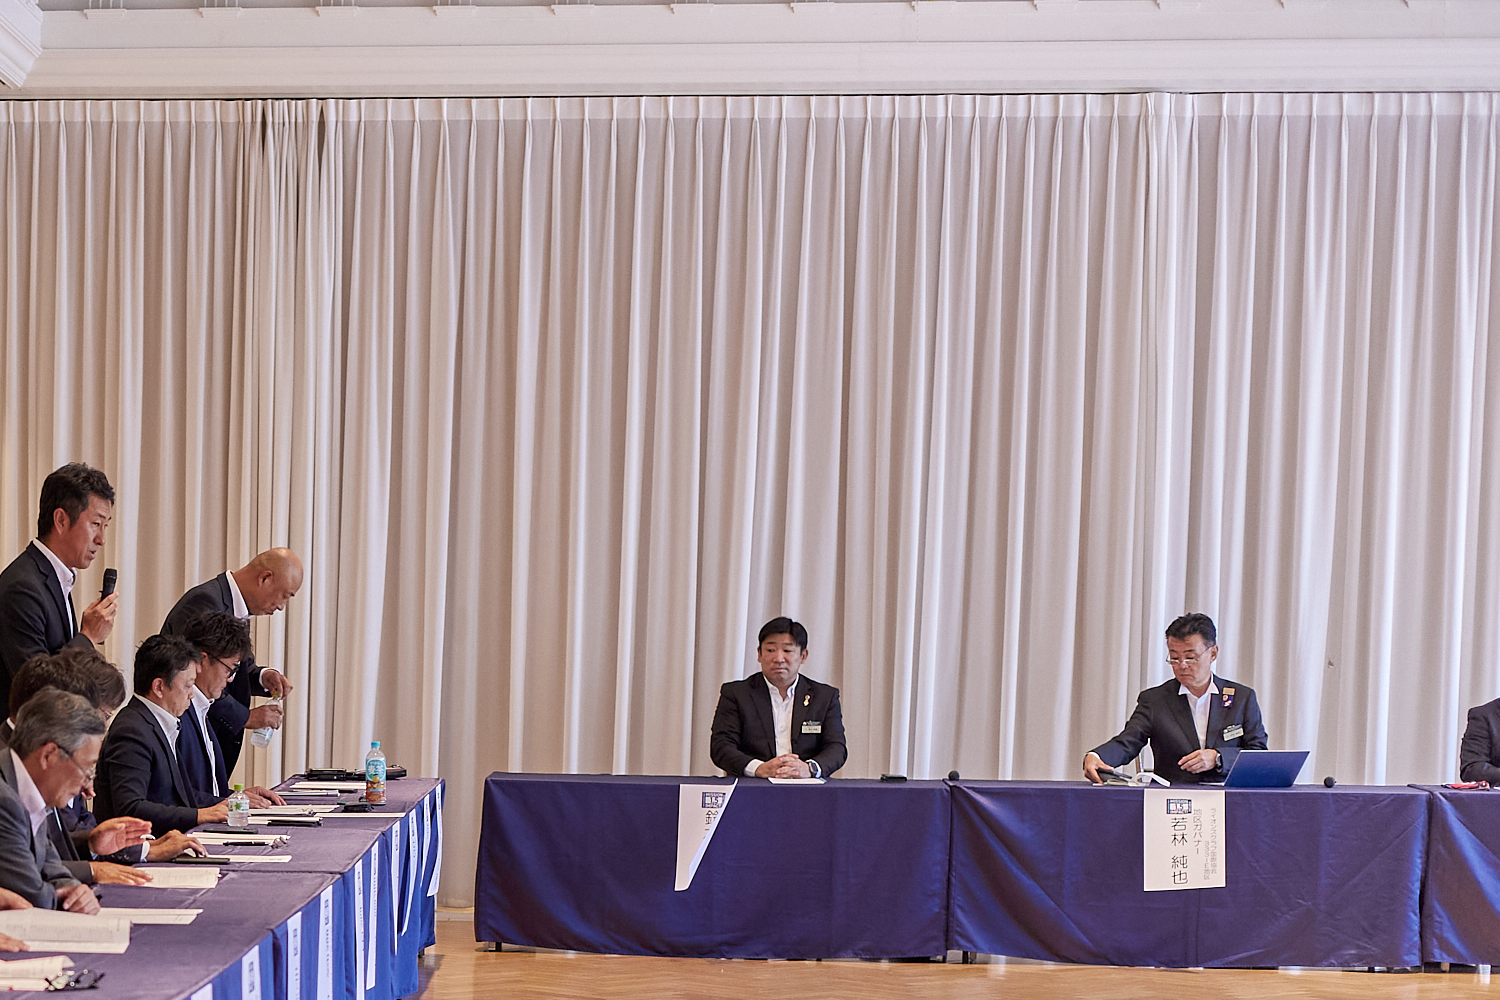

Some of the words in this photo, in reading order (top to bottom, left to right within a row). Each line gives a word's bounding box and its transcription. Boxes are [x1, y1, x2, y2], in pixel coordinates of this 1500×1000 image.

[1171, 817, 1188, 847] 若林
[1193, 808, 1203, 855] 地区ガバナー
[1171, 855, 1188, 885] 純也
